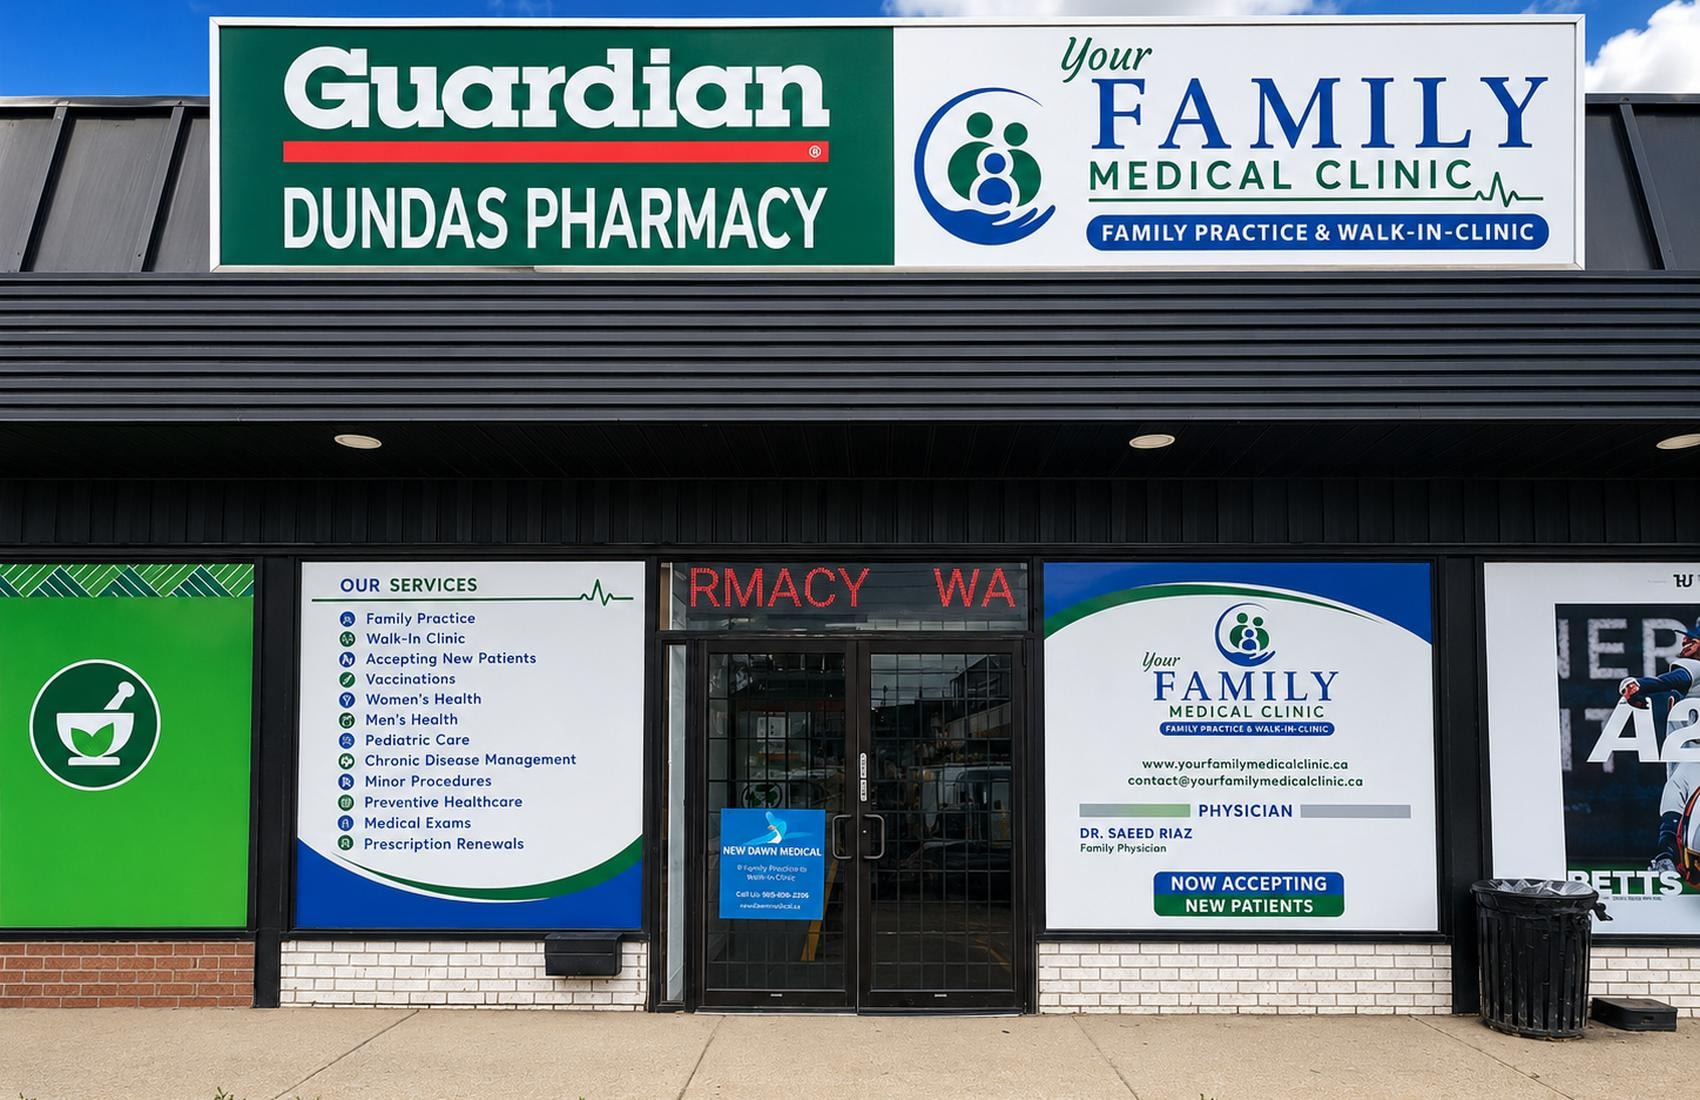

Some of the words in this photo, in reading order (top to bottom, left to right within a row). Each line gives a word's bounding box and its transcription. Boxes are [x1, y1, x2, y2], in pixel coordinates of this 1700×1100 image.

[1060, 36, 1152, 83] Your
[284, 47, 829, 129] Guardian
[1092, 77, 1548, 149] FAMILY
[1089, 160, 1292, 191] MEDICAL
[1316, 160, 1472, 191] CLINIC
[284, 187, 507, 249] DUNDAS
[528, 187, 827, 249] PHARMACY
[1102, 224, 1188, 242] FAMILY
[1195, 223, 1308, 242] PRACTICE
[1314, 223, 1330, 241] &
[1337, 223, 1534, 241] WALK-IN-CLINIC
[340, 578, 380, 593] OUR
[389, 577, 478, 593] SERVICES
[691, 567, 869, 608] RMACY
[934, 568, 1015, 608] WA
[366, 612, 413, 627] Family
[417, 611, 476, 625] Practice
[366, 632, 421, 645] Walk-In
[426, 631, 466, 645] Clinic
[1558, 618, 1688, 679] ER
[365, 652, 437, 668] Accepting
[442, 652, 474, 665] New
[478, 651, 537, 664] Patients
[1142, 651, 1181, 672] Your
[365, 672, 456, 686] Vaccinations
[1154, 671, 1338, 701] FAMILY
[365, 693, 430, 706] Women's
[434, 692, 482, 705] Health
[365, 713, 407, 726] Men's
[411, 712, 458, 726] Health
[1169, 705, 1253, 718] MEDICAL
[1261, 705, 1324, 719] CLINIC
[1165, 724, 1199, 733] FAMILY
[1200, 724, 1244, 733] PRACTICE
[365, 733, 431, 746] Pediatric
[435, 733, 470, 746] Care
[364, 754, 420, 767] Chronic
[425, 753, 480, 767] Disease
[485, 753, 577, 769] Management
[1141, 757, 1349, 772] www.yourfamilymedicalclinic.ca
[365, 775, 406, 788] Minor
[411, 774, 492, 788] Procedures
[1127, 774, 1363, 789] contact@yourfamilymedicalclinic.ca
[364, 795, 439, 809] Preventive
[444, 795, 523, 808] Healthcare
[1198, 804, 1293, 818] PHYSICIAN
[364, 816, 421, 830] Medical
[425, 816, 472, 829] Exams
[1080, 827, 1104, 839] DR.
[1108, 827, 1155, 839] SAEED
[1159, 827, 1193, 840] RIAZ
[364, 837, 452, 853] Prescription
[457, 837, 525, 850] Renewals
[722, 846, 746, 856] NEW
[747, 846, 777, 857] DAWN
[779, 846, 822, 857] MEDICAL
[1080, 843, 1115, 855] Family
[1117, 843, 1167, 855] Physician
[1171, 875, 1217, 891] NOW
[1221, 875, 1327, 892] ACCEPTING
[1185, 898, 1226, 913] NEW
[1231, 898, 1314, 913] PATIENTS
